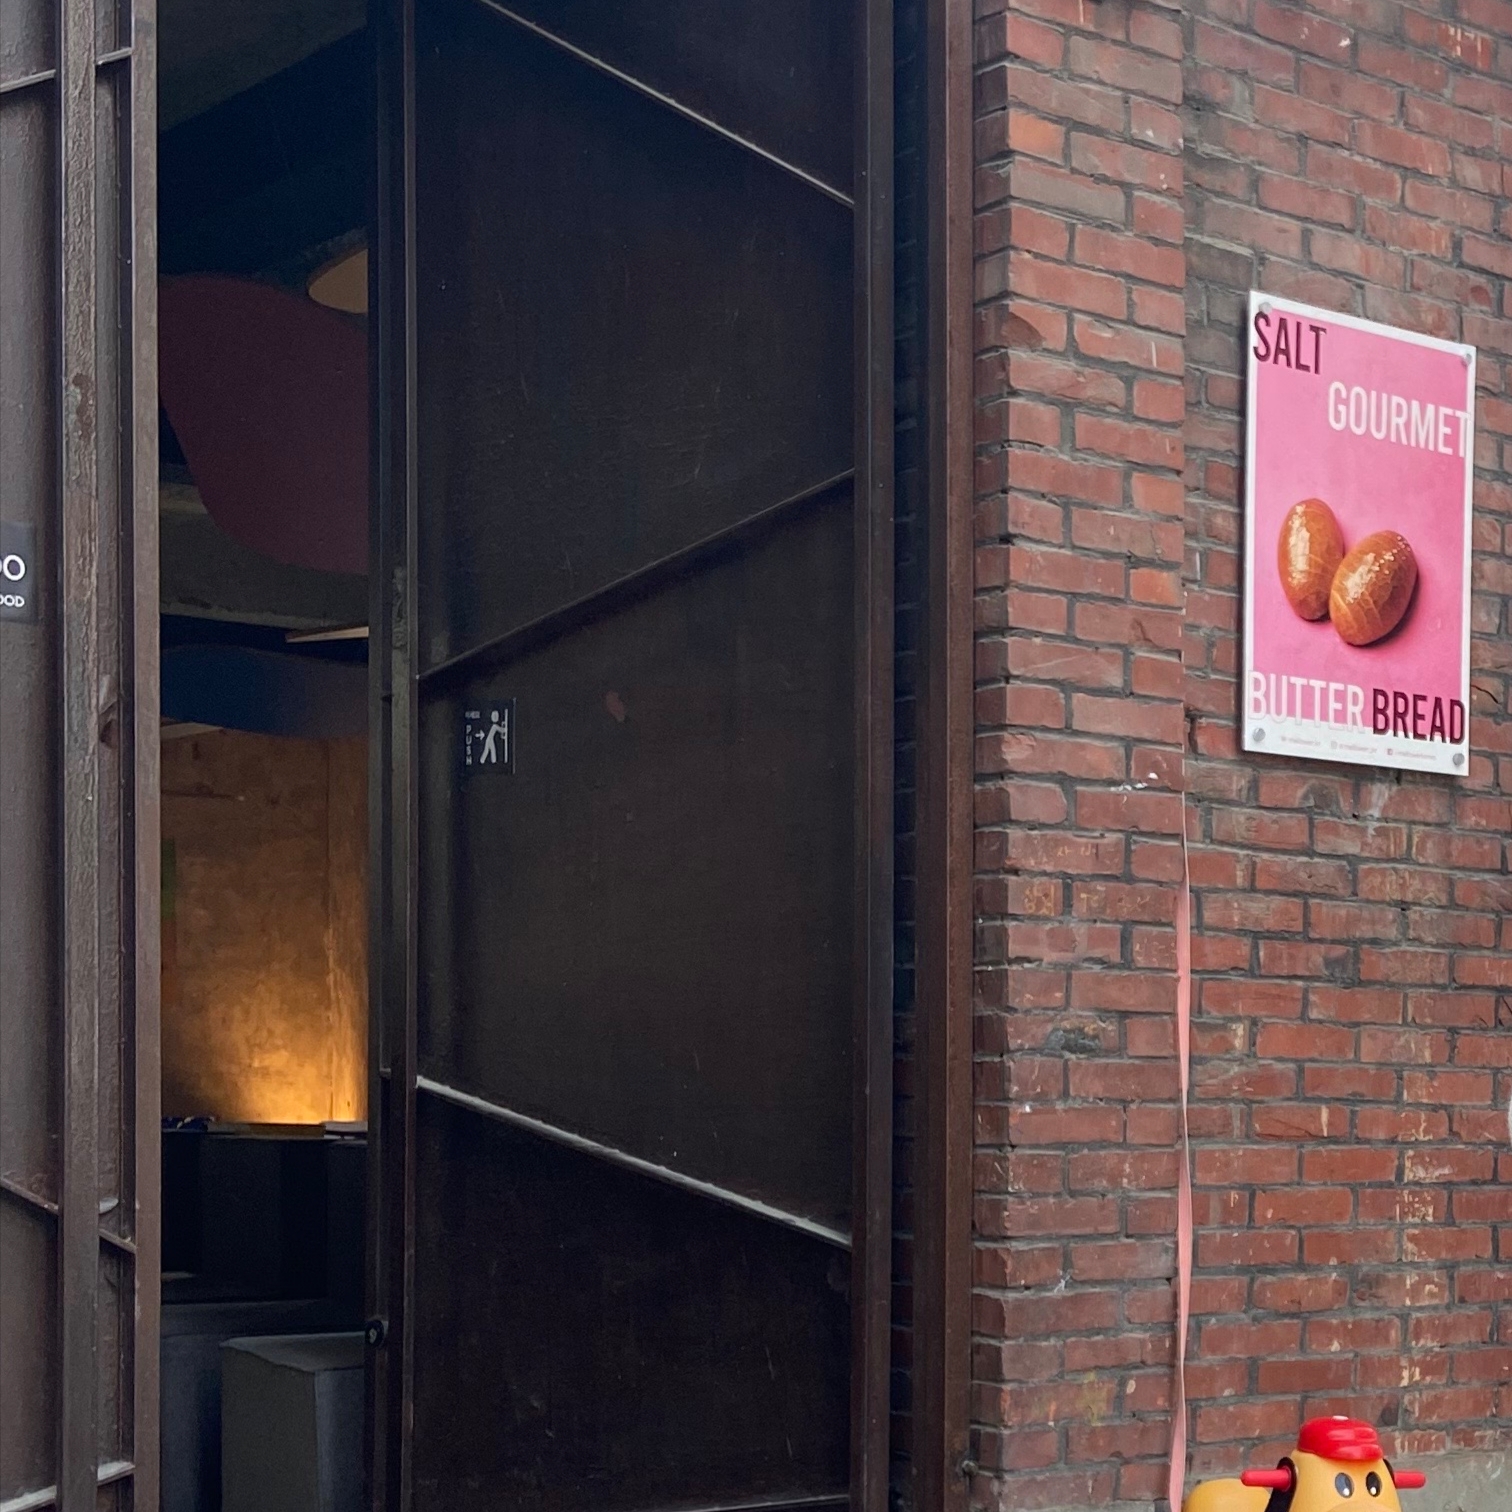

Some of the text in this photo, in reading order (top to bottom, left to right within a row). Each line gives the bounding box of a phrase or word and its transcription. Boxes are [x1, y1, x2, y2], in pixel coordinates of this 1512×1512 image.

[1253, 311, 1327, 375] SALT
[1328, 381, 1472, 458] GOURMET
[1247, 670, 1466, 745] BUTTER BREAD
[465, 724, 473, 766] PUSH
